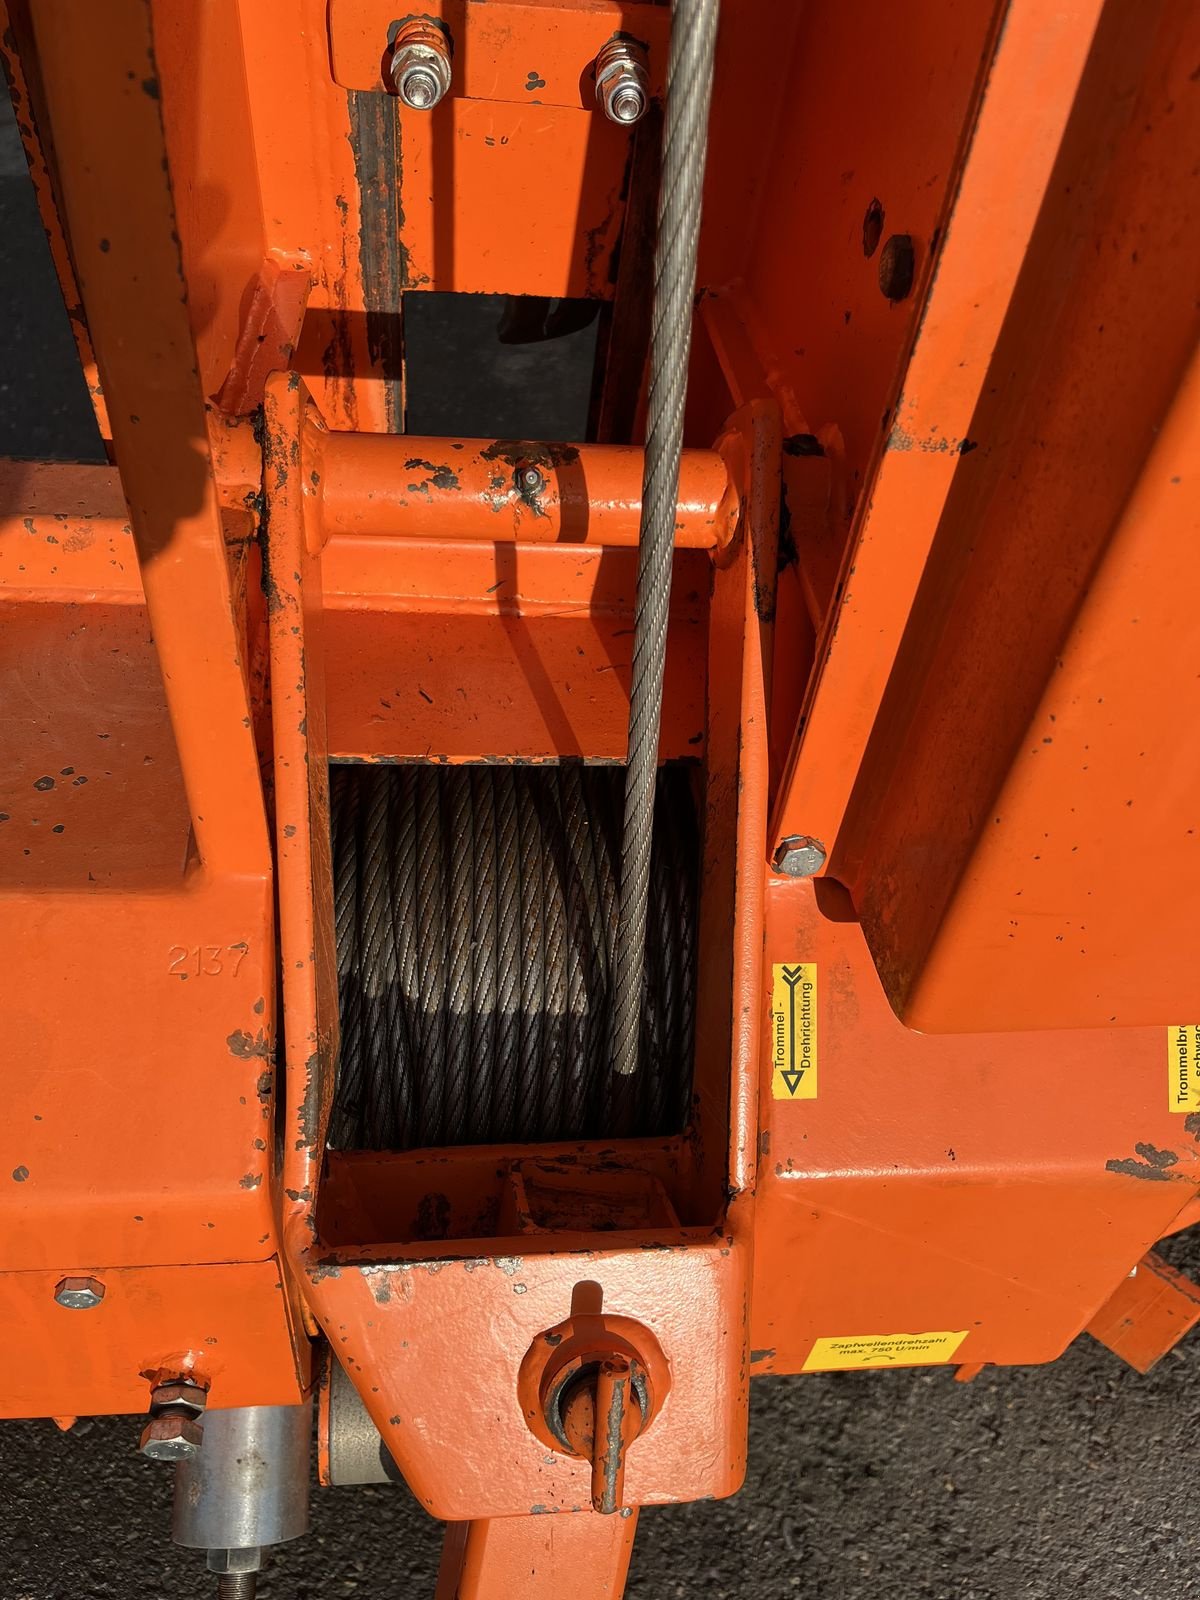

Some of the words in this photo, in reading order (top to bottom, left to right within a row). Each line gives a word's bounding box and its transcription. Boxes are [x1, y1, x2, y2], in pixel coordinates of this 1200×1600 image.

[167, 942, 249, 978] 2137
[774, 1011, 785, 1069] Trommel
[800, 982, 813, 1069] Drehrichtung
[1176, 1025, 1189, 1104] Trommelbr
[830, 1337, 948, 1349] Zapfwellendrehzahl
